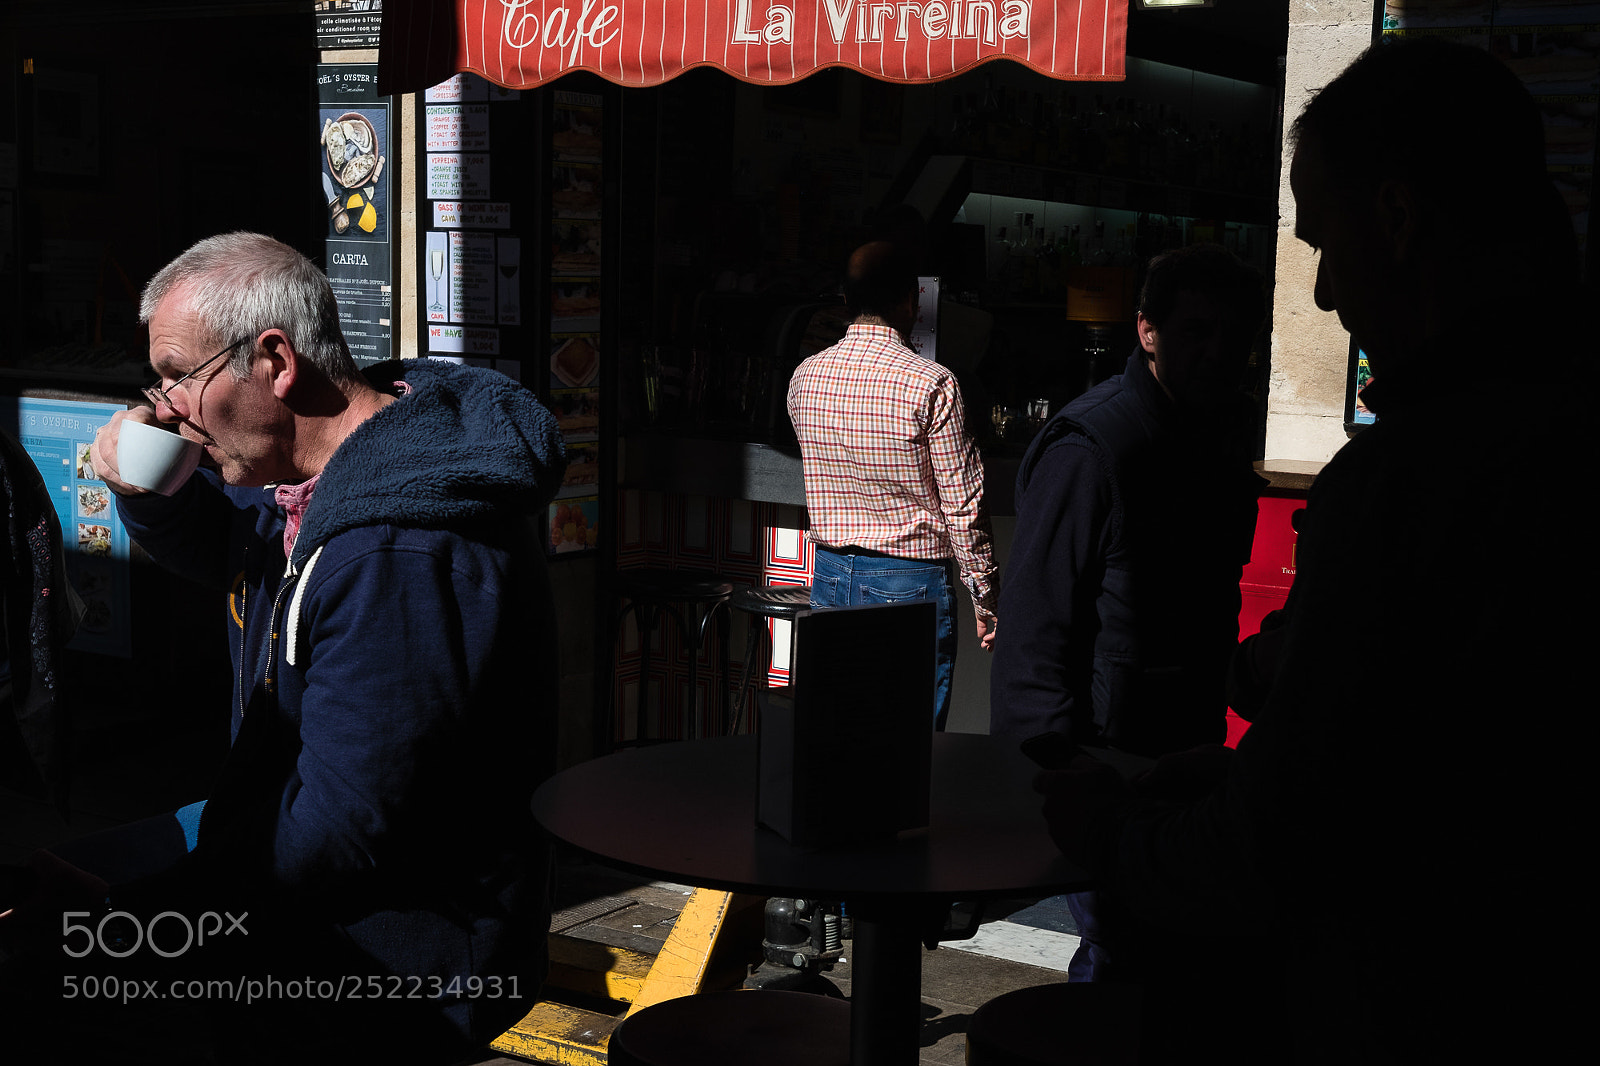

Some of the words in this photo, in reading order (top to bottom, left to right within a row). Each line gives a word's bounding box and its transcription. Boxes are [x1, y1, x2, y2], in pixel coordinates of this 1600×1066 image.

[731, 0, 795, 45] La
[823, 0, 1031, 46] Virreina
[343, 73, 370, 82] OYSTER
[427, 107, 464, 115] CONTINENTAL
[438, 204, 453, 212] GASS
[457, 204, 464, 212] OF
[332, 254, 368, 266] CARTA
[431, 328, 441, 337] WE
[444, 329, 462, 338] HAVE
[42, 416, 80, 430] OYSTER
[20, 437, 43, 446] CARTA
